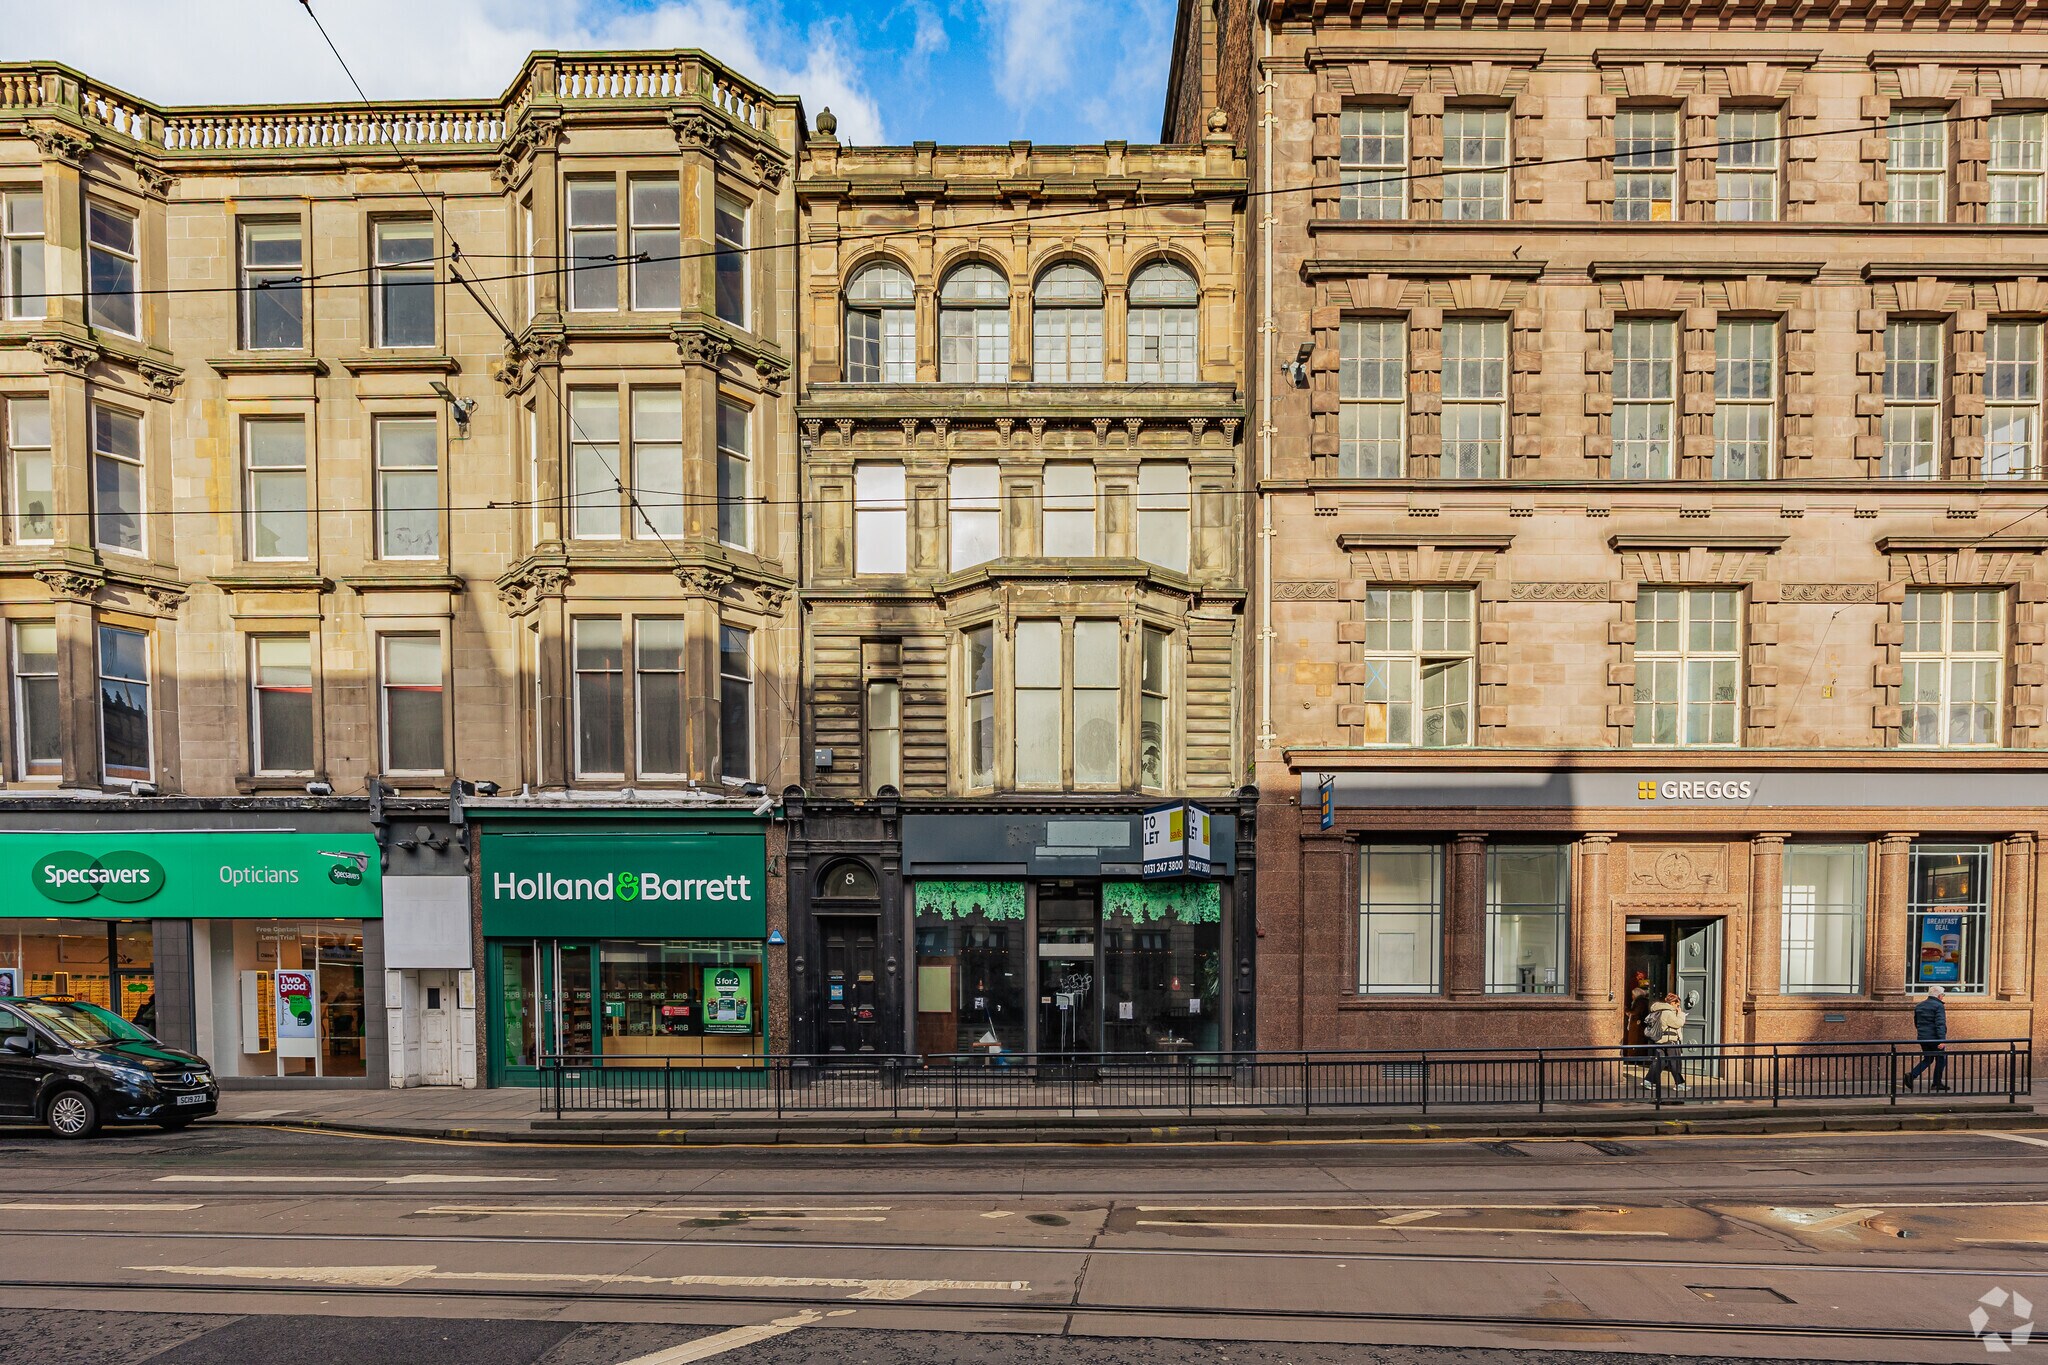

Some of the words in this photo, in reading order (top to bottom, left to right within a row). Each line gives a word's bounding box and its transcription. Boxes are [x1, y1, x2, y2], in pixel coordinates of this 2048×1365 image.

[1661, 781, 1751, 799] GREGGS
[1144, 815, 1156, 830] TO
[1145, 831, 1159, 845] LET
[1143, 863, 1156, 874] 0131
[1156, 861, 1168, 873] 247
[1168, 859, 1184, 872] 3800
[44, 865, 150, 888] Specsavers
[219, 865, 299, 887] Opticians
[333, 868, 360, 881] Specsavers
[845, 873, 855, 885] 8
[280, 975, 301, 984] Two
[716, 977, 721, 985] 3
[721, 977, 732, 985] for
[733, 977, 739, 985] 2
[180, 1096, 193, 1104] SC19
[194, 1095, 204, 1103] ZZJ
